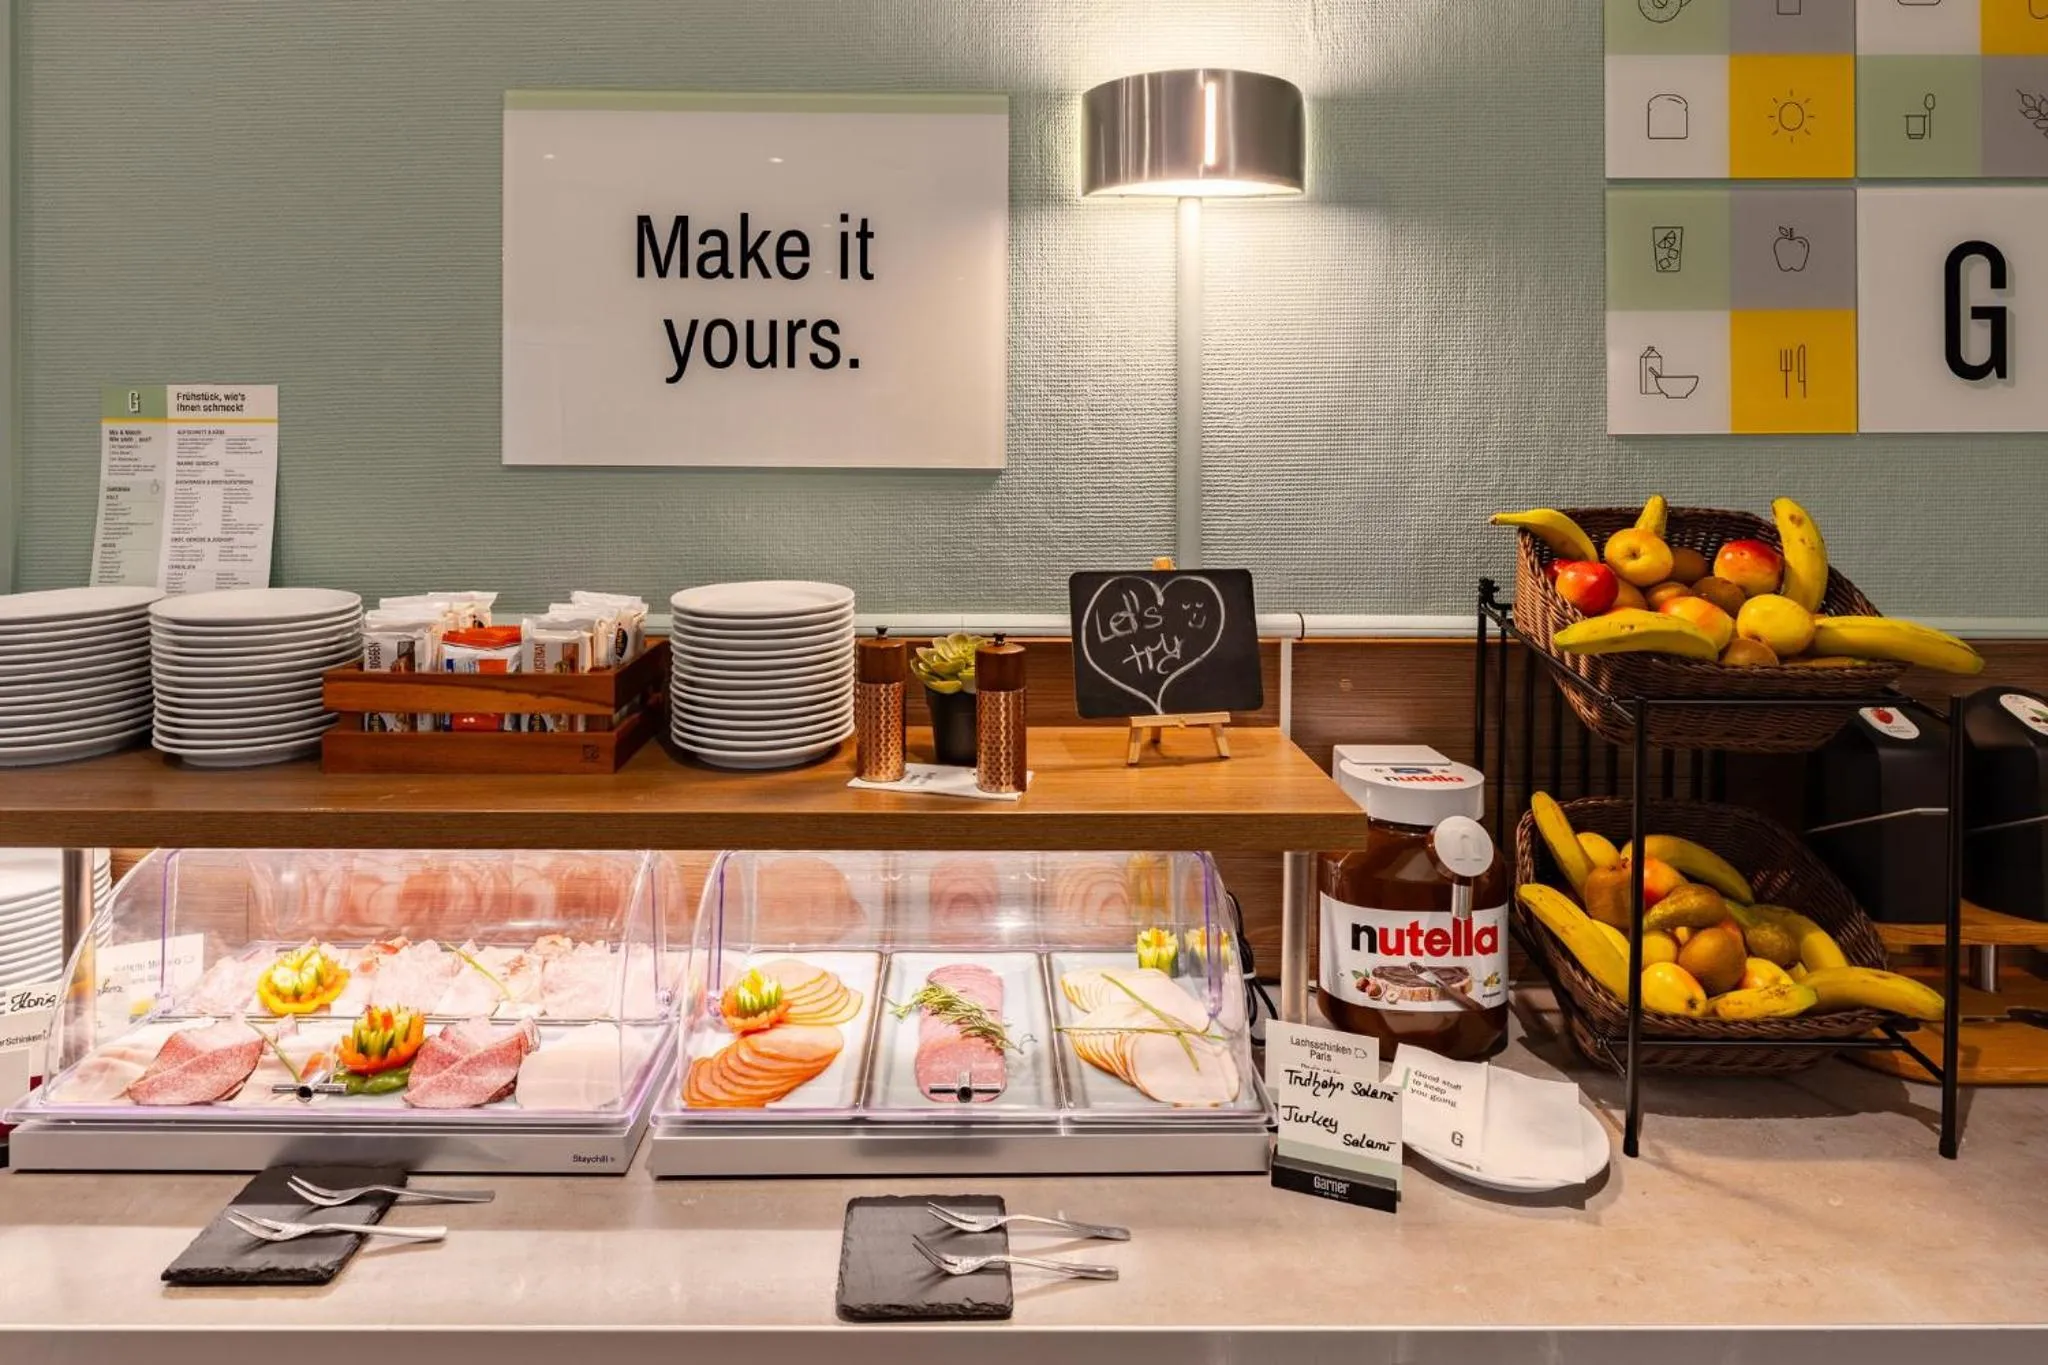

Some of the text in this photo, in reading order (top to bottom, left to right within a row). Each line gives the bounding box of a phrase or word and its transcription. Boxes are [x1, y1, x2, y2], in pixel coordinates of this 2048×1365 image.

[636, 212, 875, 281] Make it
[1944, 240, 2007, 381] G
[663, 318, 861, 385] yours.
[128, 391, 141, 413] G
[176, 392, 246, 402] Frühstück, wie's
[176, 403, 244, 413] Ihnen schmeckt
[1384, 775, 1465, 784] nutella
[1351, 916, 1499, 957] nutella
[1290, 1036, 1352, 1056] Lachsschinken
[1310, 1049, 1332, 1062] Paris
[1414, 1069, 1440, 1083] Good
[1411, 1087, 1428, 1098] you
[1412, 1078, 1447, 1095] to keep
[1451, 1130, 1464, 1148] G
[1313, 1174, 1351, 1195] Garner
